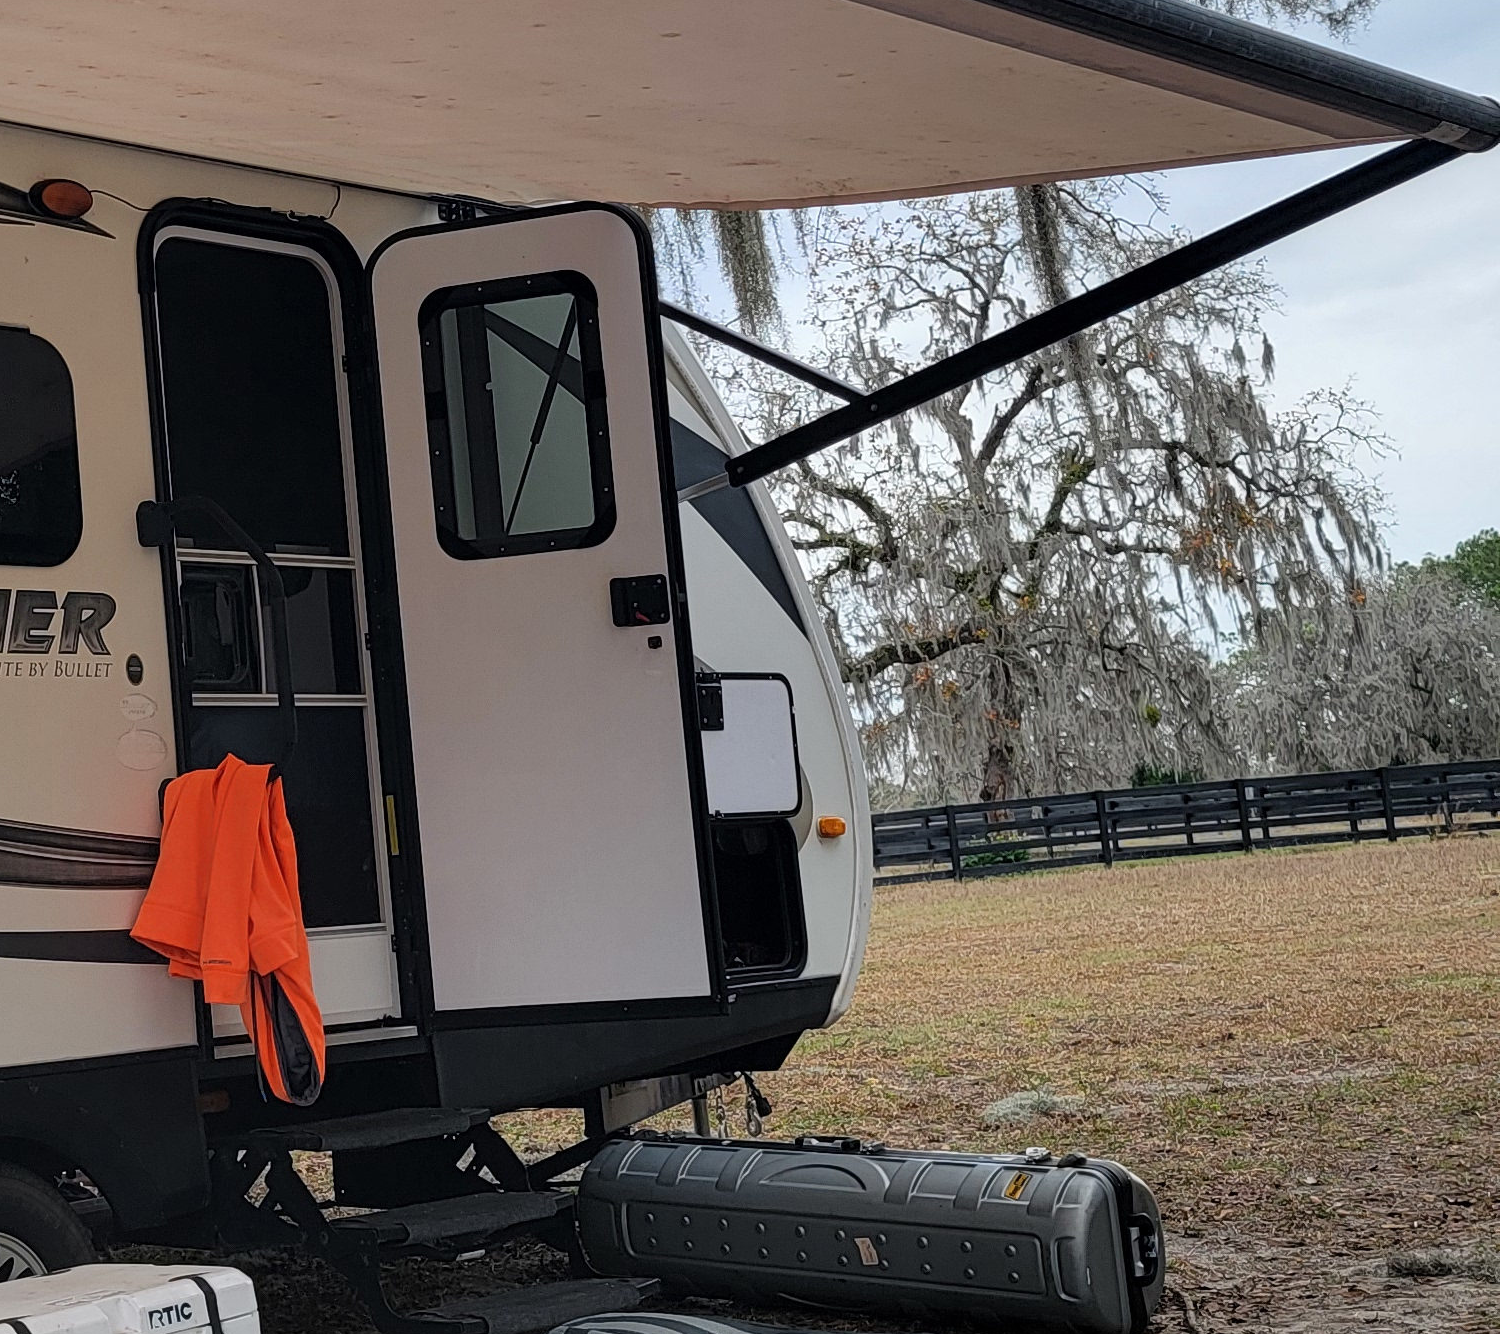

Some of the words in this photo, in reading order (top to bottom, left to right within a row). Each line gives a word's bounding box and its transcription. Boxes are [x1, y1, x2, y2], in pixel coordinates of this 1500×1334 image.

[28, 661, 49, 678] BY
[54, 660, 114, 678] BULLET
[148, 1302, 193, 1330] RTIC
